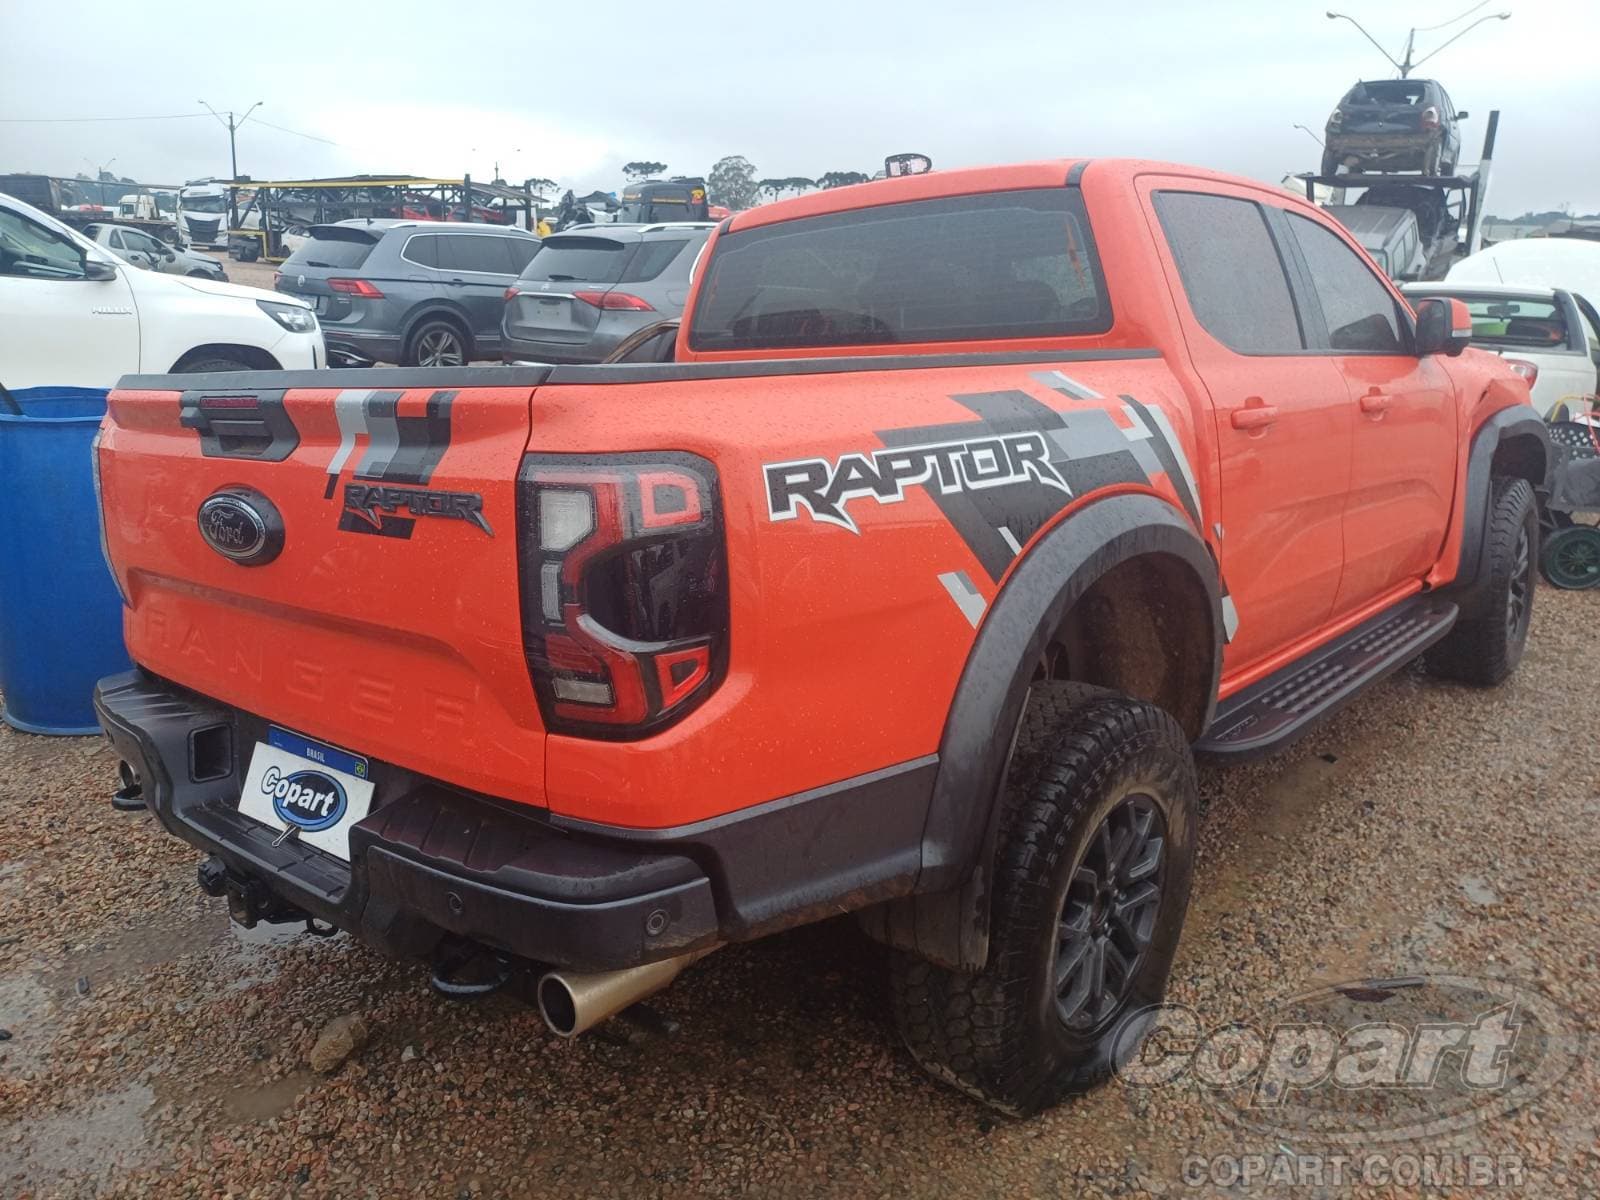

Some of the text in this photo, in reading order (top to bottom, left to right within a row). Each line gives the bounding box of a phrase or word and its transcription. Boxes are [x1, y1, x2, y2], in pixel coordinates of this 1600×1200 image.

[762, 430, 1074, 536] RAPTOR
[206, 509, 244, 545] Ford
[344, 482, 496, 538] RAPTOR
[306, 747, 326, 764] BRASIL
[261, 765, 335, 818] Copart
